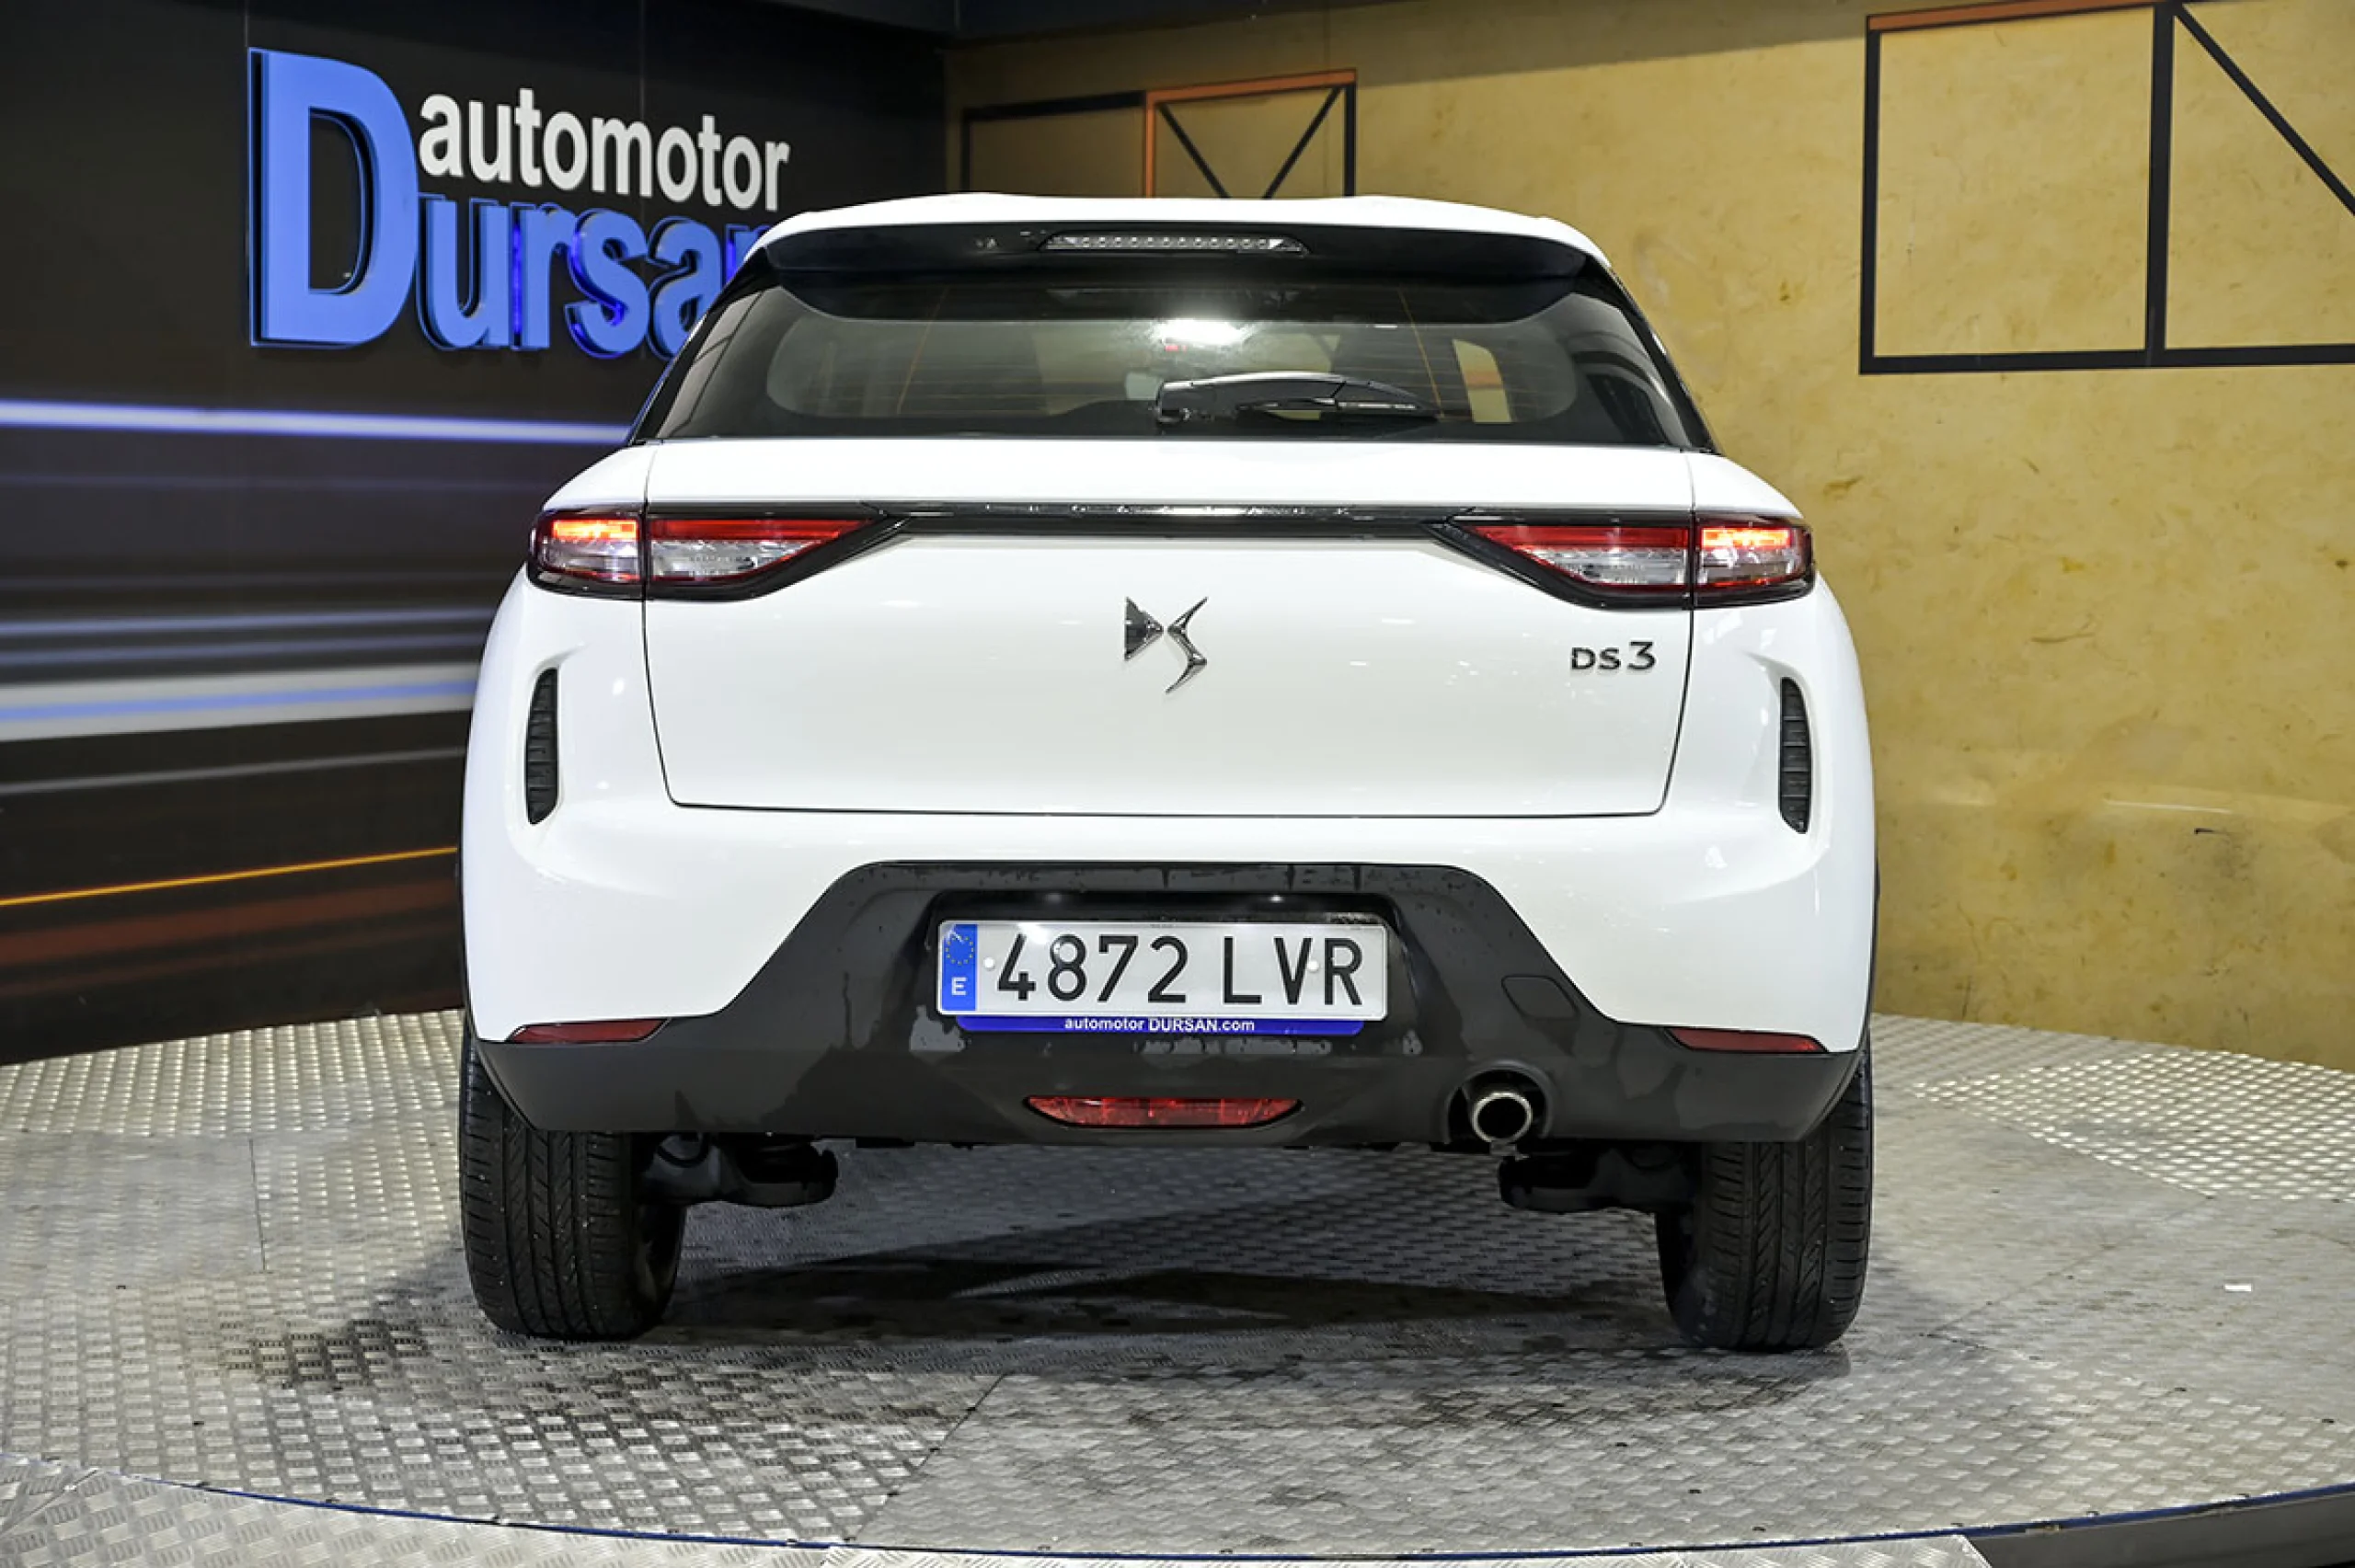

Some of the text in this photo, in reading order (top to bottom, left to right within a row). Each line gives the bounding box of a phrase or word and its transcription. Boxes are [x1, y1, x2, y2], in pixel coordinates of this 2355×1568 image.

[419, 88, 790, 212] automotor
[950, 977, 968, 996] E
[997, 933, 1363, 1005] 4872 LVR
[1064, 1016, 1256, 1033] automotor DURSAN.com
